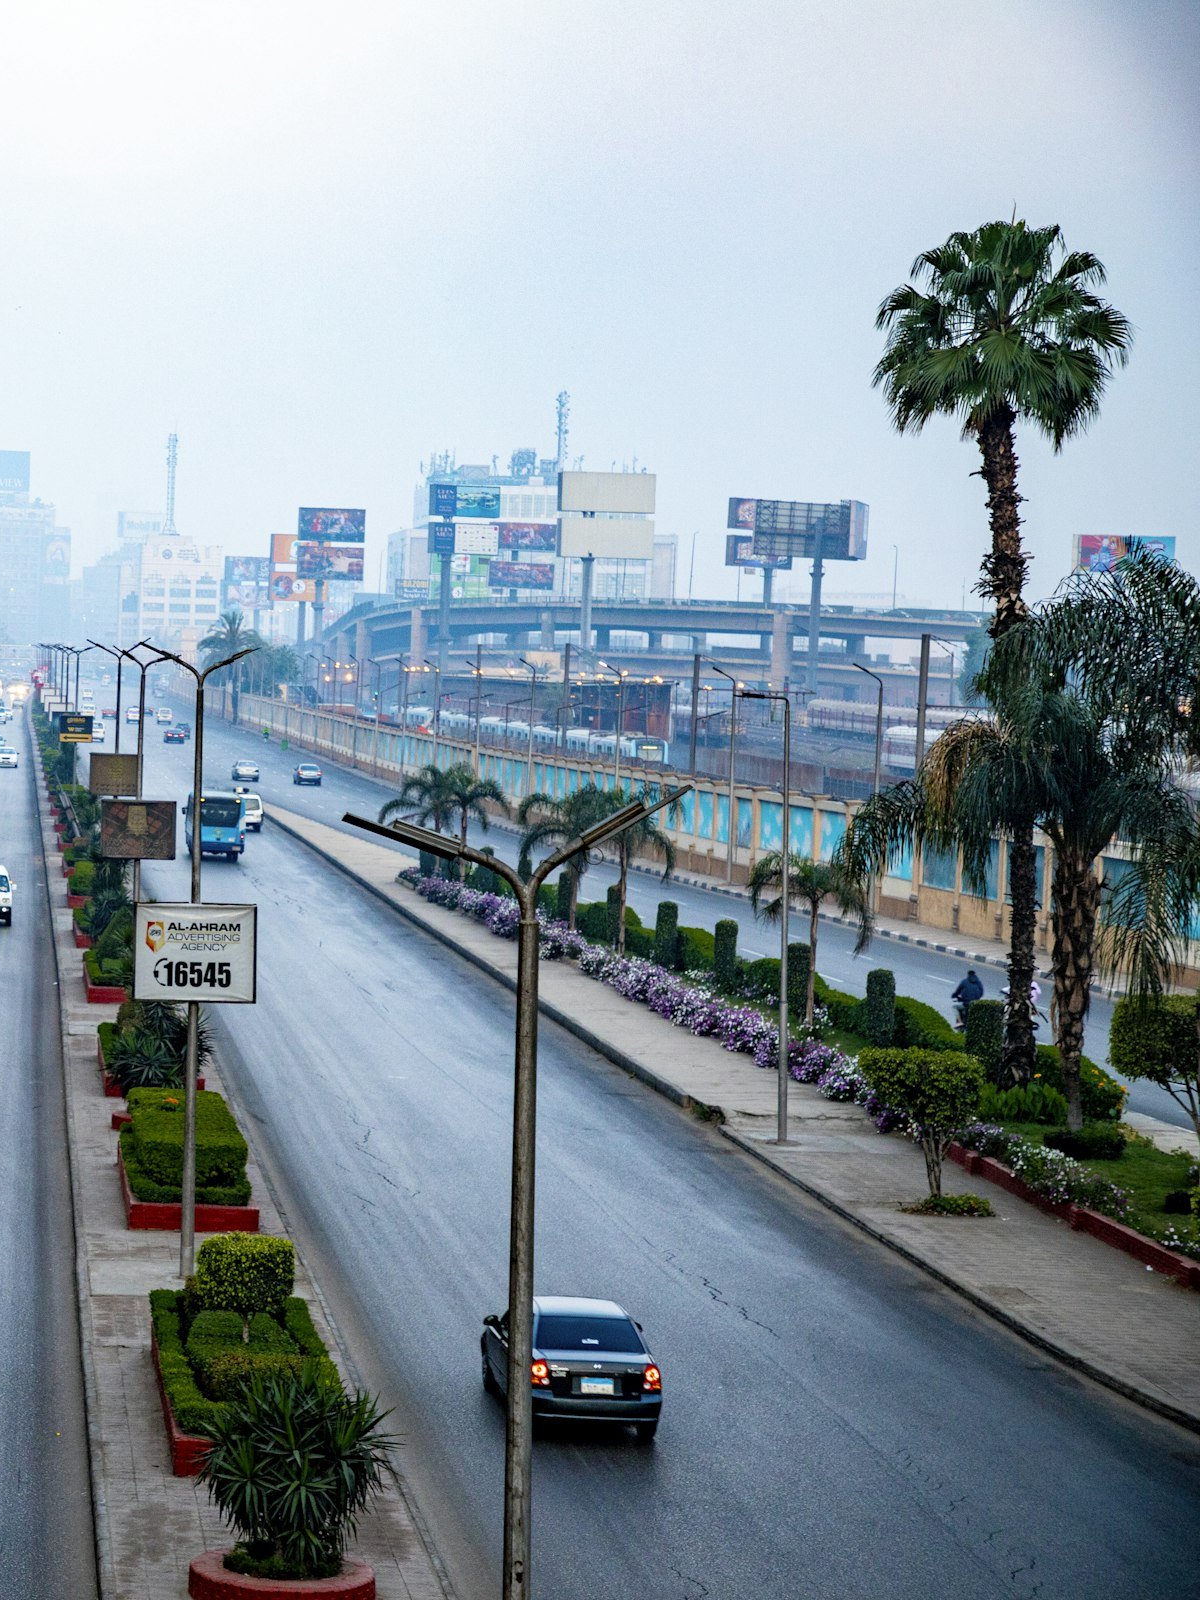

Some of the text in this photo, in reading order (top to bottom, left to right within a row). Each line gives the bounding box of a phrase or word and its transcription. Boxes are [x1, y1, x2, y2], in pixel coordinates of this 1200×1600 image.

[0, 477, 23, 488] VIEW
[167, 933, 241, 942] ADVERTISING
[180, 943, 228, 951] AGENCY
[163, 961, 231, 988] 16545
